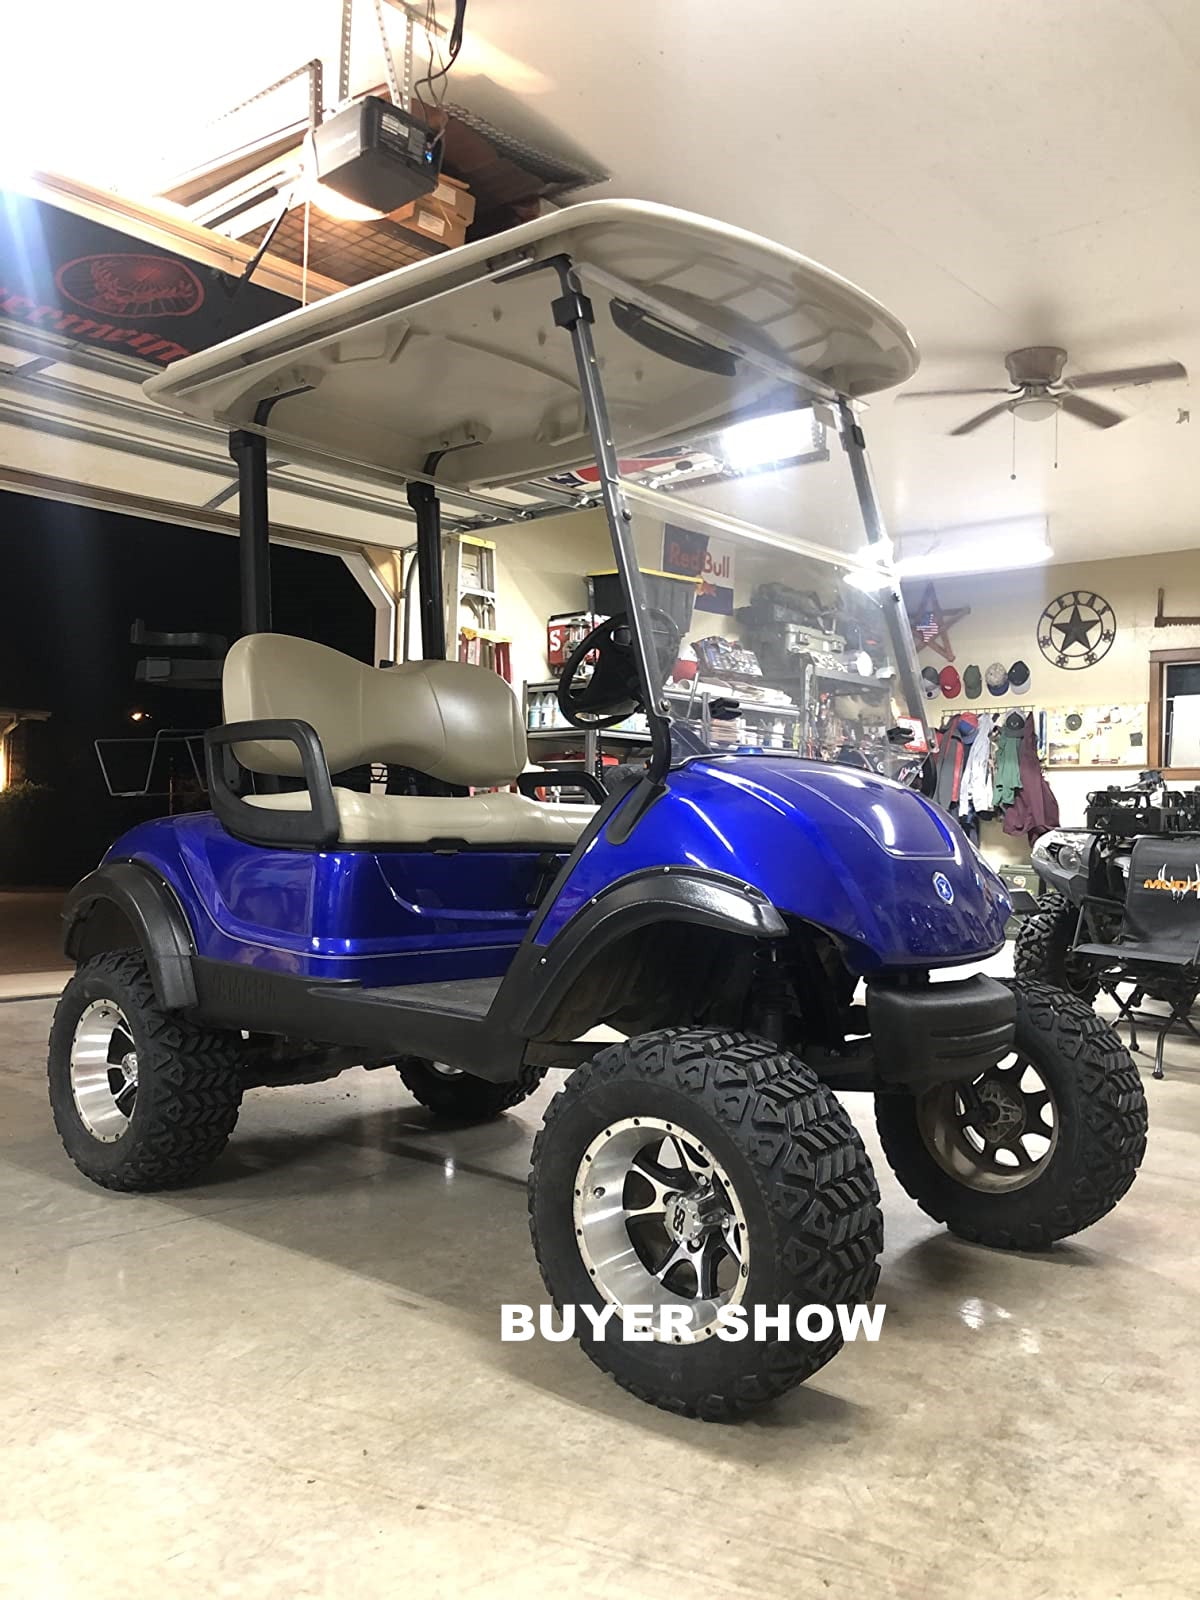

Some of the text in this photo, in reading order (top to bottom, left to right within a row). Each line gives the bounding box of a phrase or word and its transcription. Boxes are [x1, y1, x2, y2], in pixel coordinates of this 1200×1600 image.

[671, 541, 730, 579] Red Bull
[1041, 590, 1111, 620] TEXAS
